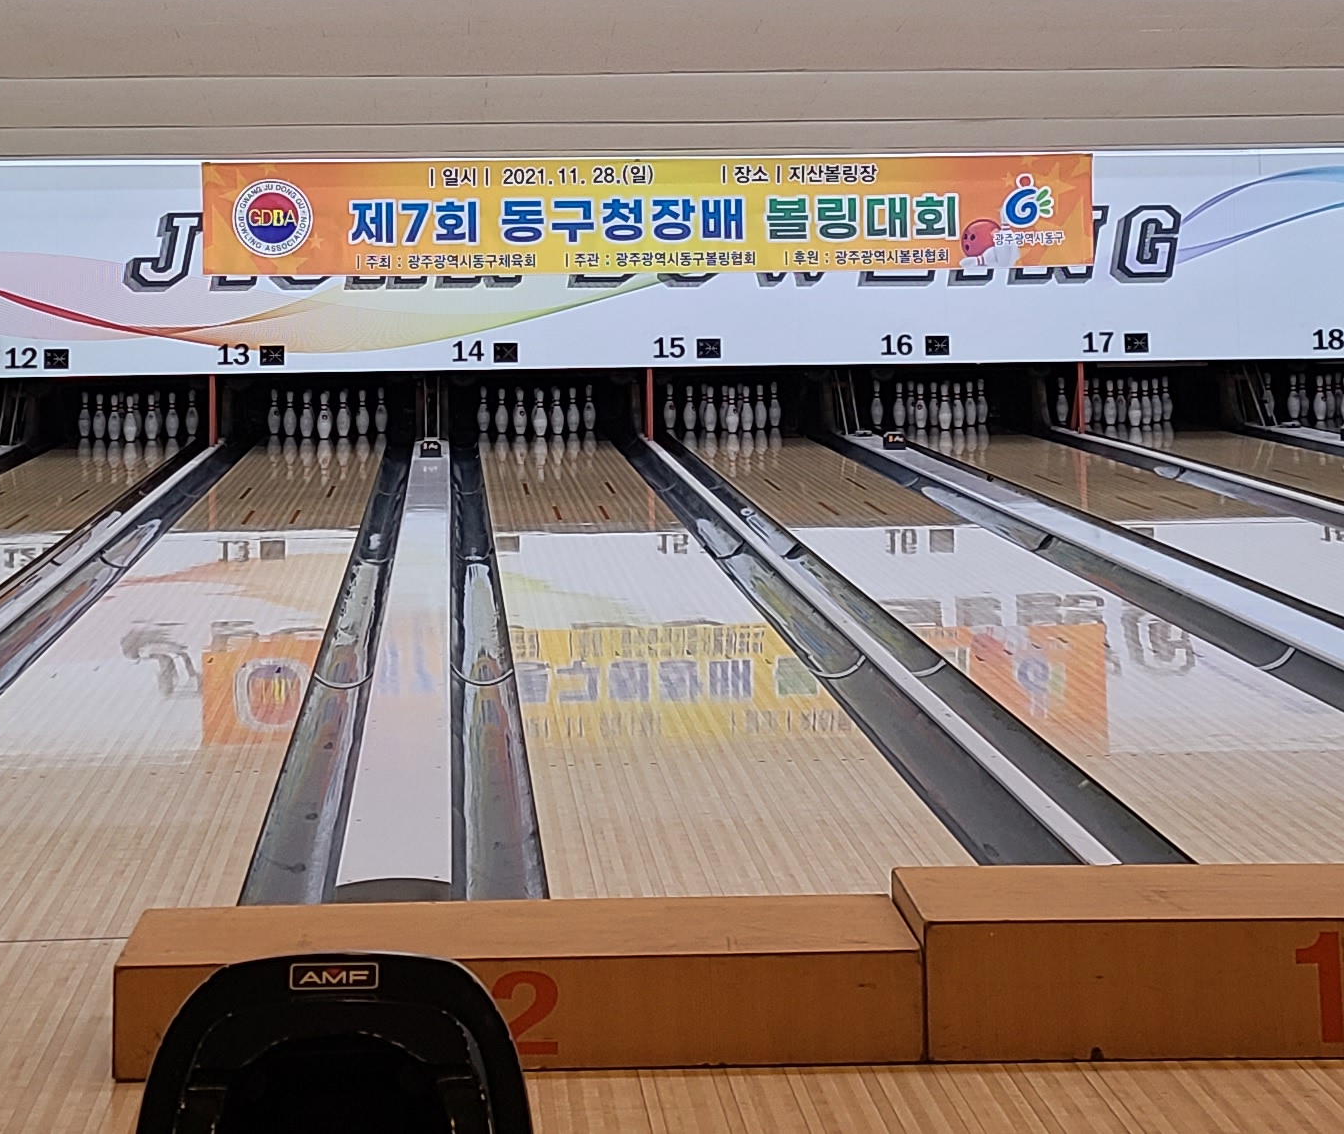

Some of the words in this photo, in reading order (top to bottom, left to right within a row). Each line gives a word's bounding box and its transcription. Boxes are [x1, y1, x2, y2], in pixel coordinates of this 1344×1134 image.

[442, 168, 478, 186] 일시
[733, 166, 770, 183] 장소
[788, 165, 878, 183] 지산볼링장
[248, 209, 298, 227] GDBA
[351, 200, 477, 243] 제7회
[501, 198, 743, 243] 동구청장배
[767, 195, 956, 240] 볼링대회
[366, 255, 391, 269] 주최
[407, 254, 536, 269] 광주광역시동구체육회
[574, 253, 600, 267] 주관
[616, 251, 756, 267] 광주광역시동구볼링협회
[793, 251, 819, 265] 후원
[834, 249, 949, 265] 광주광역시볼링협회
[653, 336, 686, 360] 15
[880, 334, 913, 356] 16
[1081, 332, 1114, 353] 17
[1312, 329, 1344, 350] 18
[5, 347, 38, 369] 12
[217, 343, 250, 366] 13
[452, 340, 484, 364] 14
[299, 970, 369, 985] AMF
[491, 970, 558, 1055] 2
